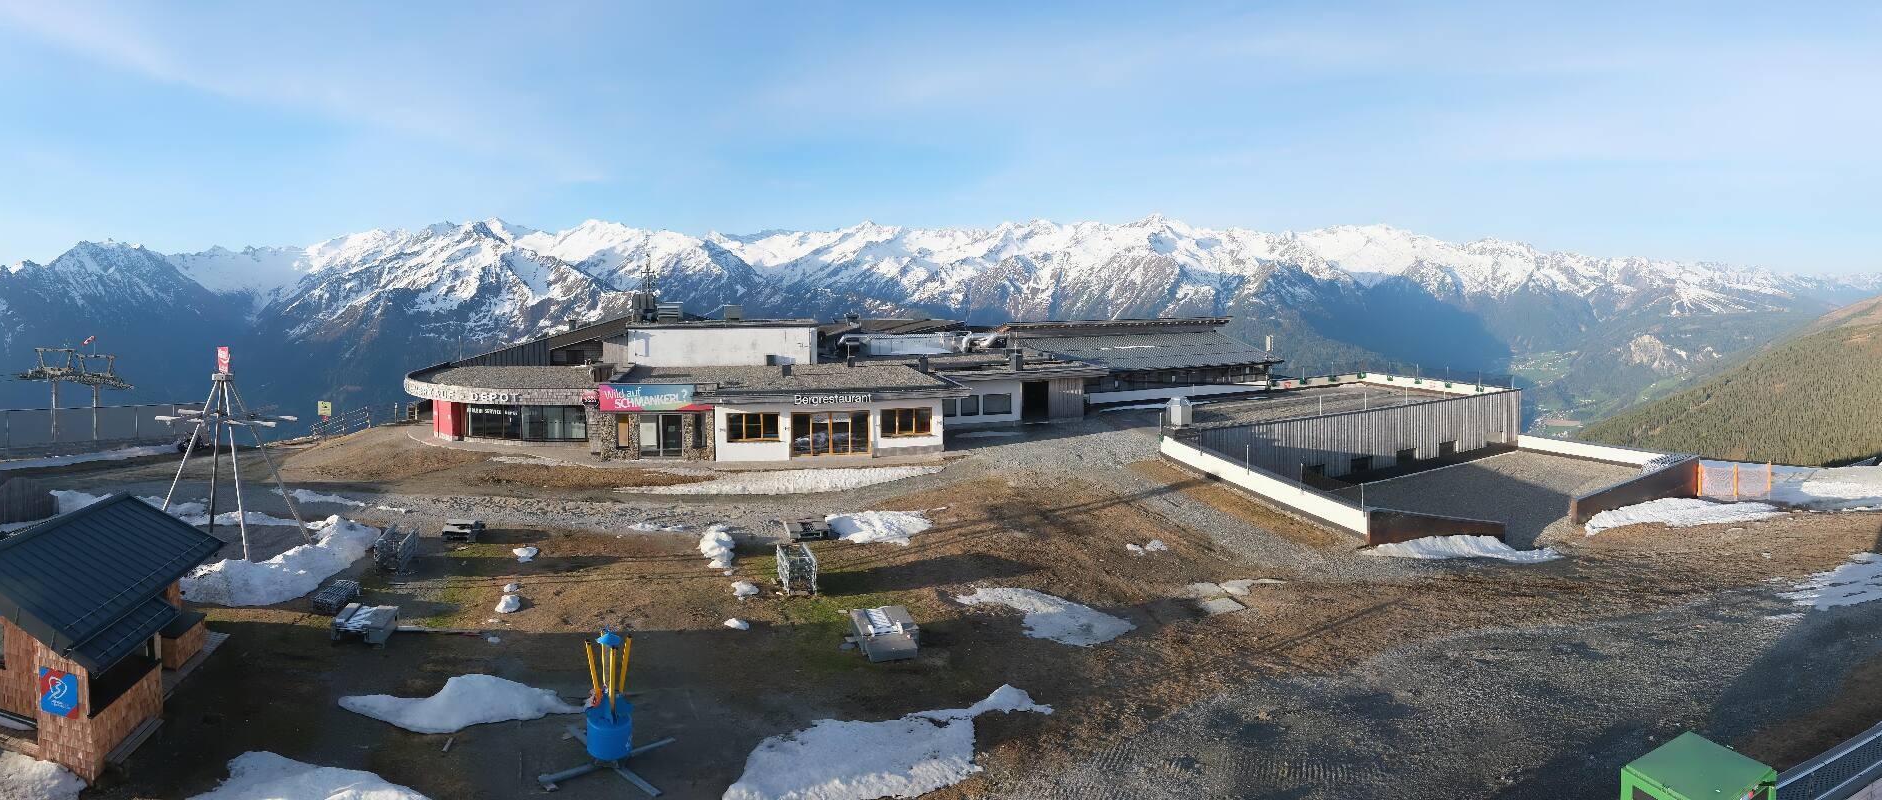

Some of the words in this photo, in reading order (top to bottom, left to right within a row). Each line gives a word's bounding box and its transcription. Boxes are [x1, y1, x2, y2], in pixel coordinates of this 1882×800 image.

[472, 392, 522, 402] DEPOT
[604, 389, 624, 400] Wild
[626, 386, 642, 398] auf
[794, 393, 872, 406] Bergrestaurant
